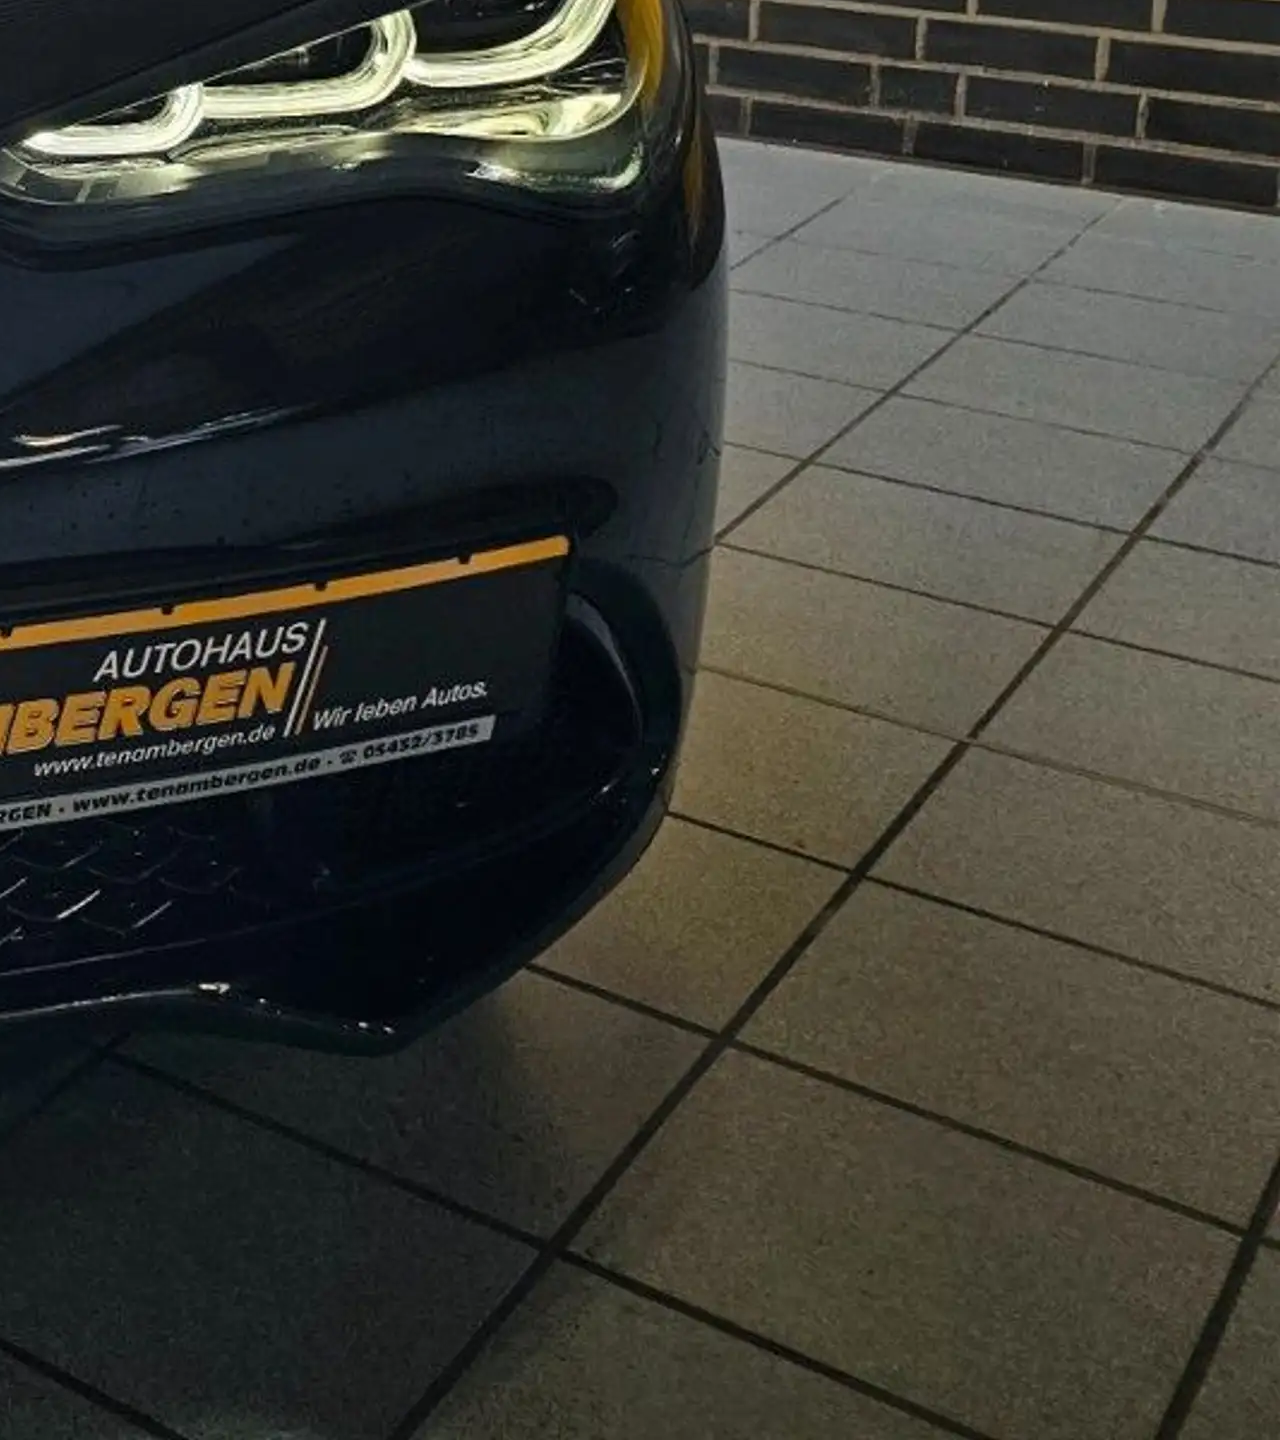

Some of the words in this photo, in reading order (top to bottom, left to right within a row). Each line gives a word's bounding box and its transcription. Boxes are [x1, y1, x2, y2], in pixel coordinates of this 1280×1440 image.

[93, 620, 310, 683] AUTOHAUS
[312, 706, 352, 731] Wir
[353, 694, 418, 723] leben
[420, 680, 489, 709] Autos.
[33, 723, 276, 778] www.tenambergen.de
[72, 755, 321, 814] www.tenambergen.de
